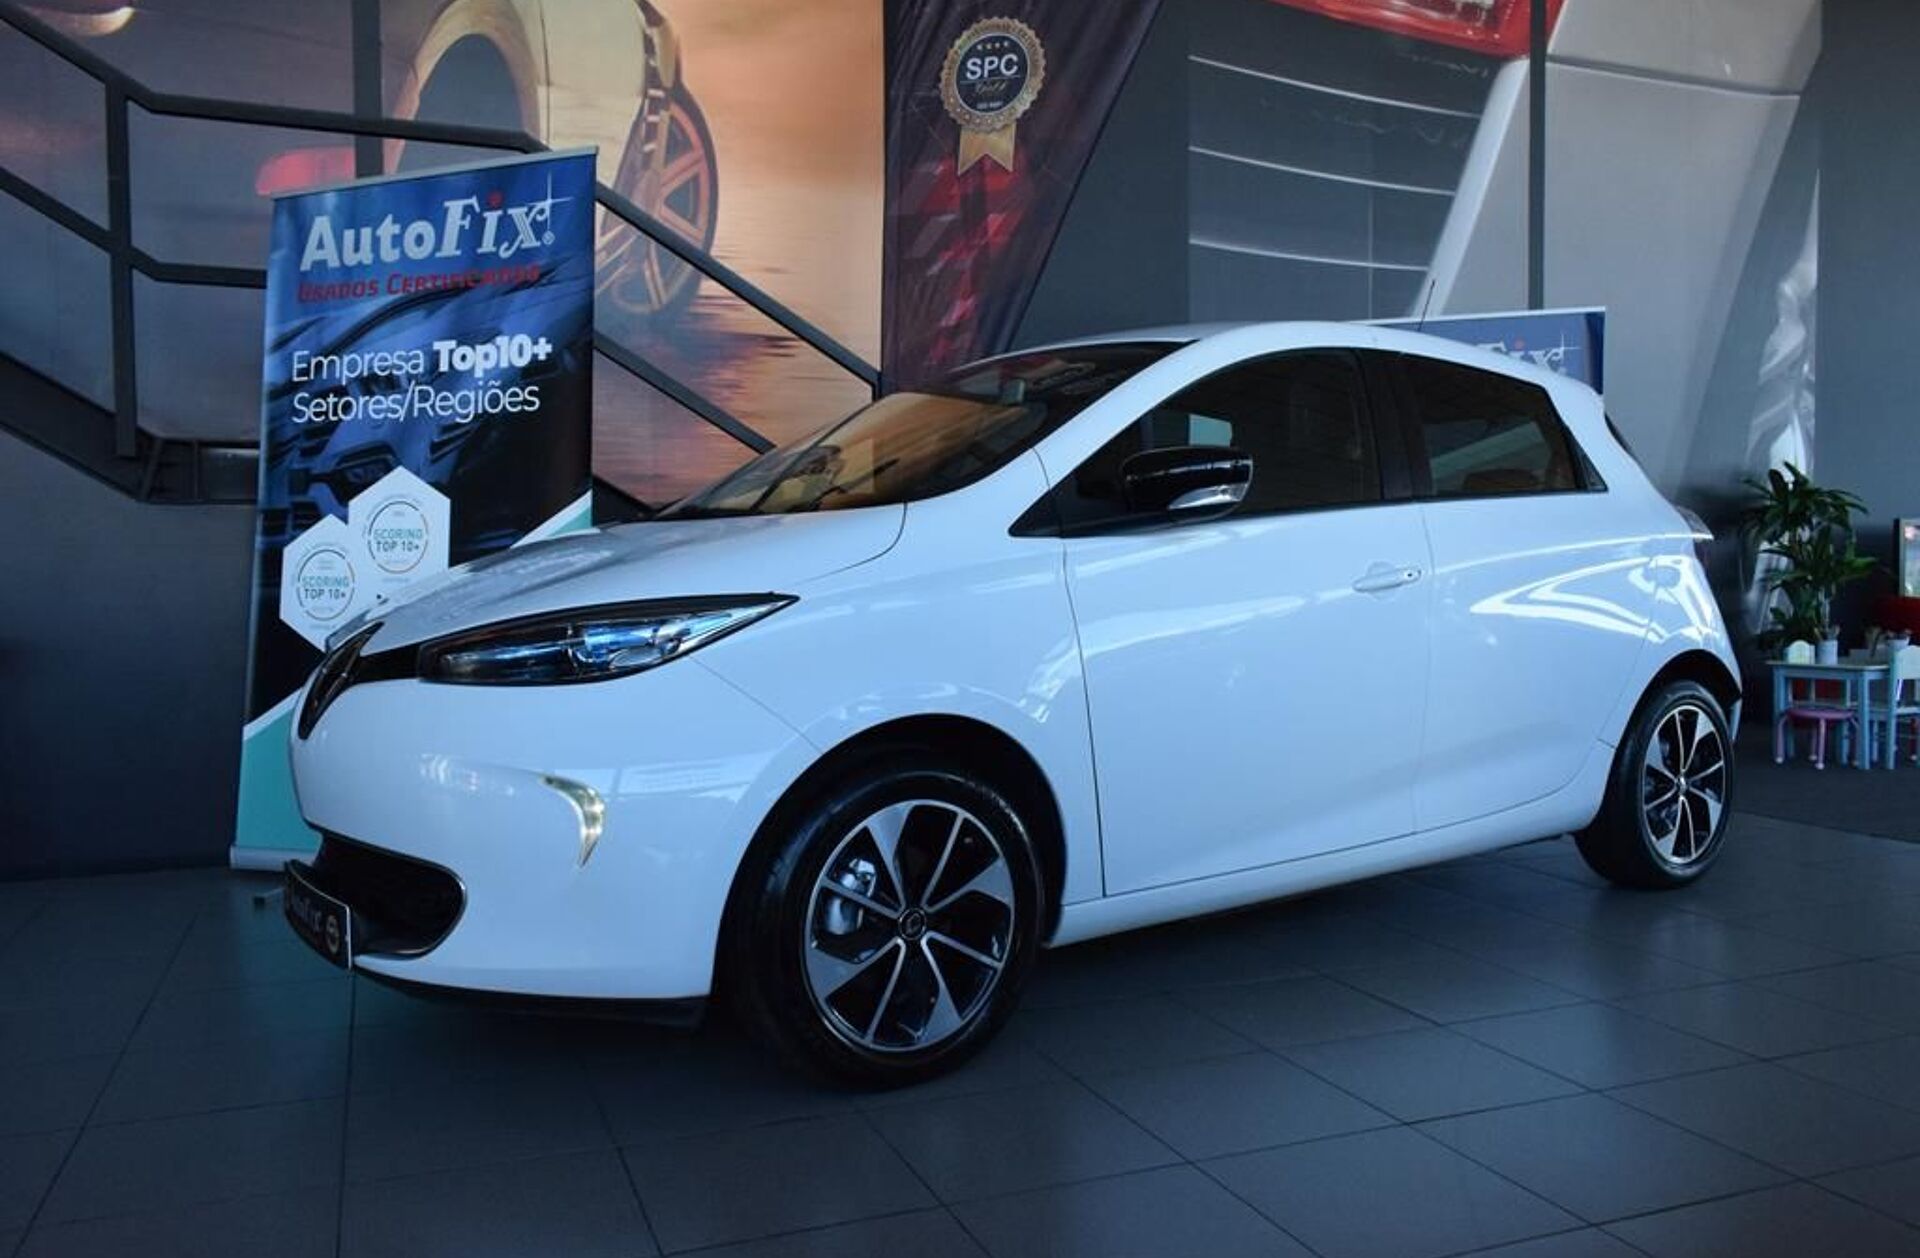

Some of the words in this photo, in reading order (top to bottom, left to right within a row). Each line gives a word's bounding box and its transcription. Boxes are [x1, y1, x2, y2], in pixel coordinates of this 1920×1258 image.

[966, 53, 1019, 80] SPC
[292, 349, 425, 385] Empresa
[433, 334, 552, 378] Top10+
[292, 380, 541, 423] Setores/Regiões
[374, 528, 423, 538] SCORING
[376, 541, 398, 552] TOP
[302, 576, 350, 588] SCORING
[304, 589, 325, 600] TOP
